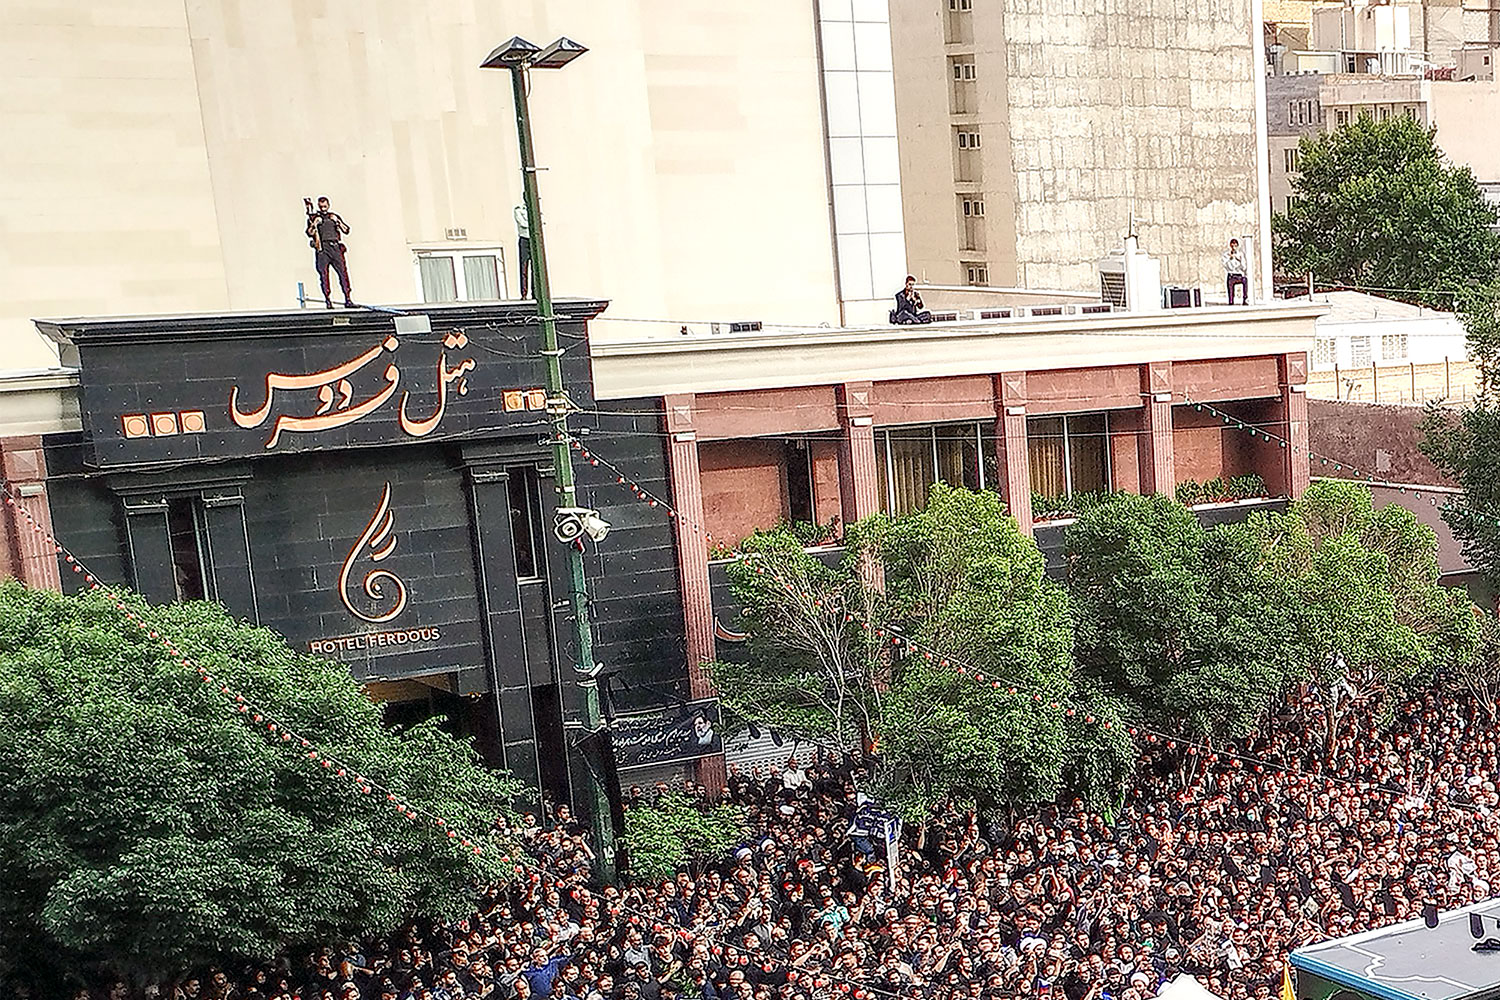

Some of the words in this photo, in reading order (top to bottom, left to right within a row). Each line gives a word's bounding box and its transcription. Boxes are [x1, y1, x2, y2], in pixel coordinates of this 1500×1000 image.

[229, 335, 400, 449] فردوس
[399, 333, 477, 437] هتل
[310, 638, 364, 654] HOTEL
[369, 628, 441, 648] FERDOUS
